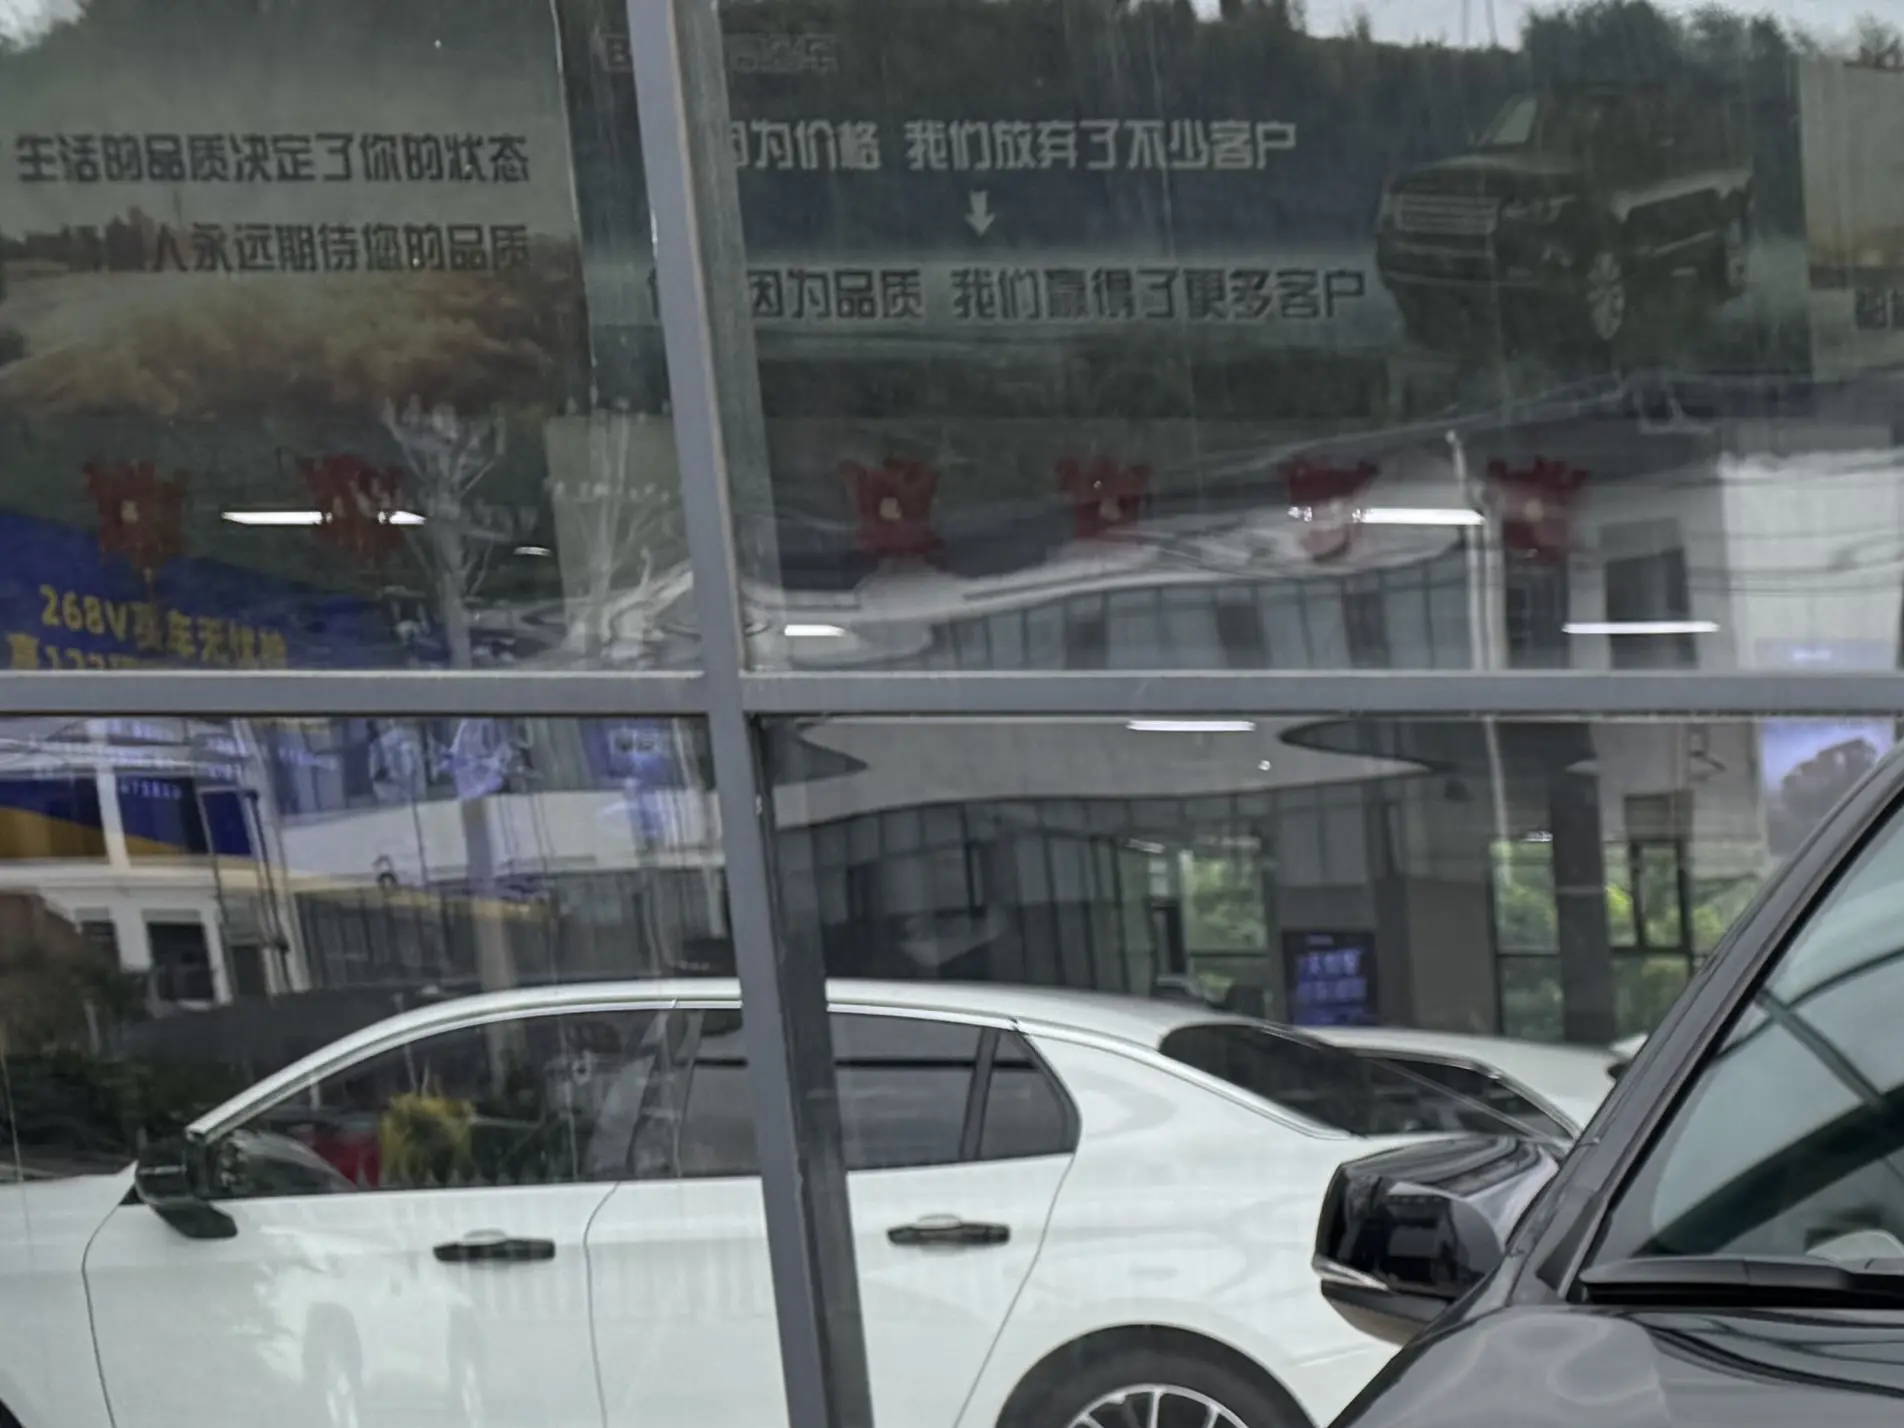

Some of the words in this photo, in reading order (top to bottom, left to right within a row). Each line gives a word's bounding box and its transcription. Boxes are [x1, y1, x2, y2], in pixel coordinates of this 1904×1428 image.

[16, 132, 531, 183] 生活的品质决定了你的状态
[904, 119, 1296, 171] 我们放弃了不少客户
[952, 268, 1365, 320] 我们赢得了更多客户
